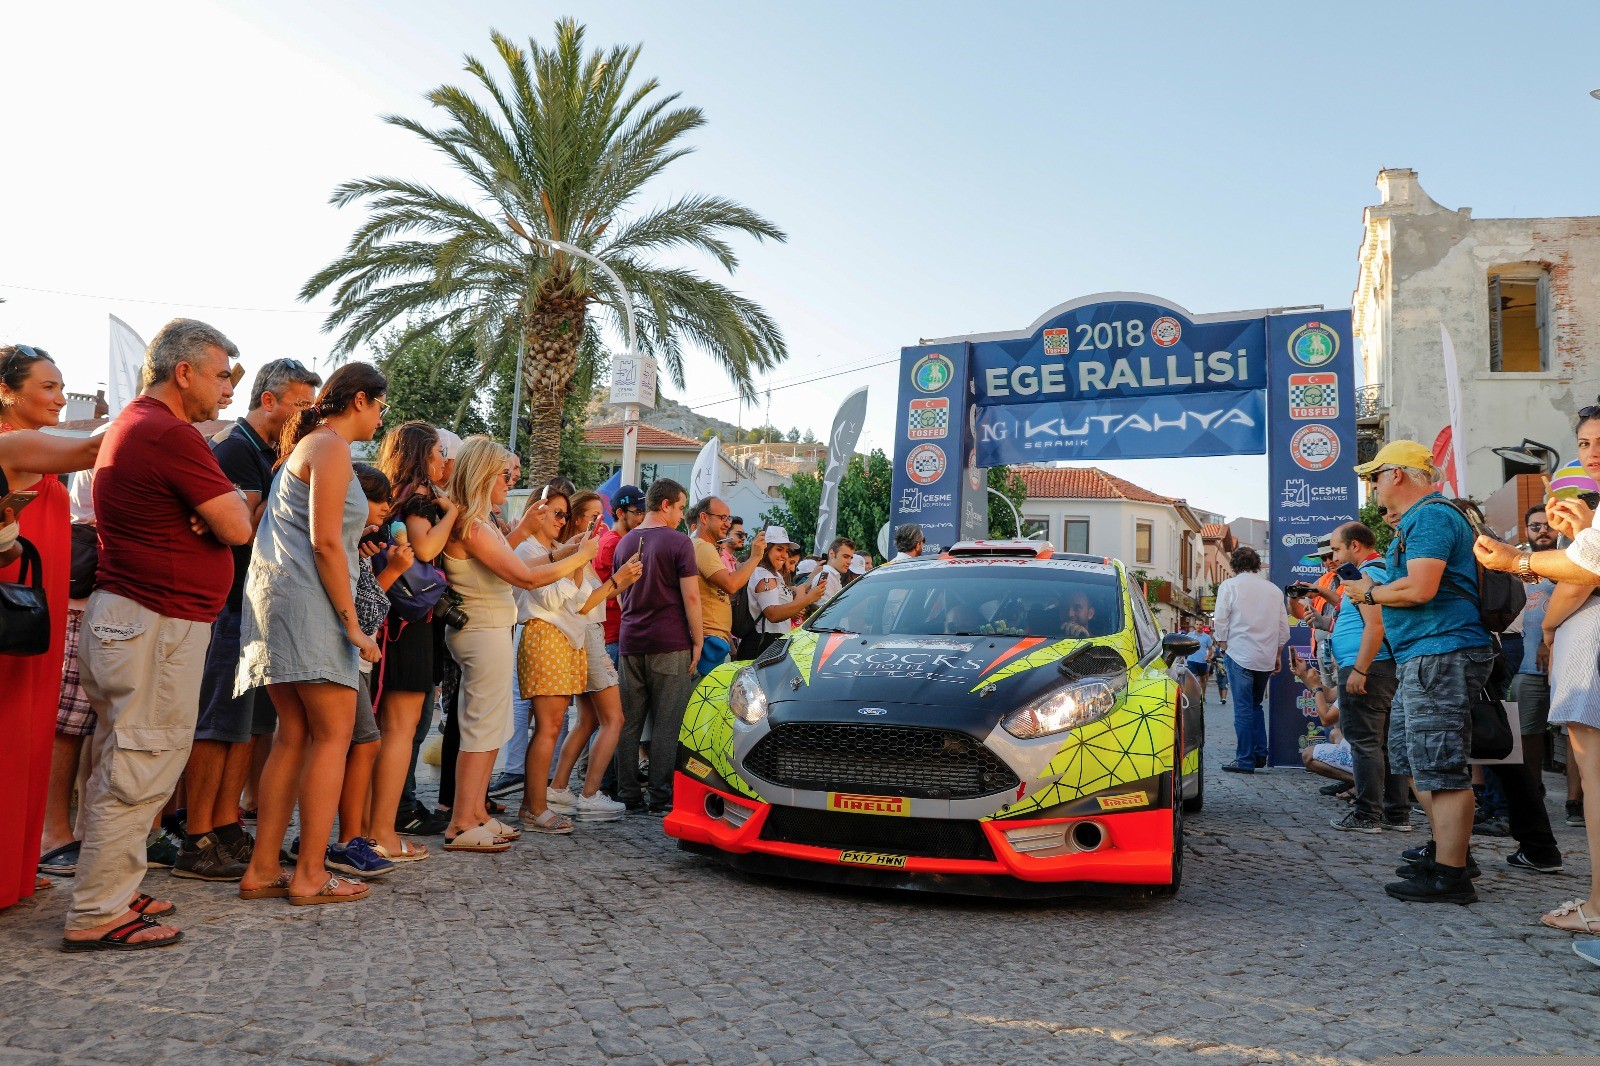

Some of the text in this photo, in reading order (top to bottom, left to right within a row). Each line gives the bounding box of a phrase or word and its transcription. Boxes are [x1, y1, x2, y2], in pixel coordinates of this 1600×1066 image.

[1075, 319, 1145, 351] 2018
[985, 363, 1067, 397] EGE
[1293, 408, 1336, 416] TOSFED
[911, 428, 945, 437] TOSFED
[981, 421, 1008, 442] NG
[1311, 486, 1348, 495] ÇEŞME
[923, 494, 952, 502] ÇEŞME
[830, 653, 985, 671] ROCKS
[867, 663, 924, 671] HOTEL
[833, 793, 903, 813] PIRELLI
[1102, 794, 1144, 807] PIRELLI
[842, 851, 903, 866] PX17 HWN
